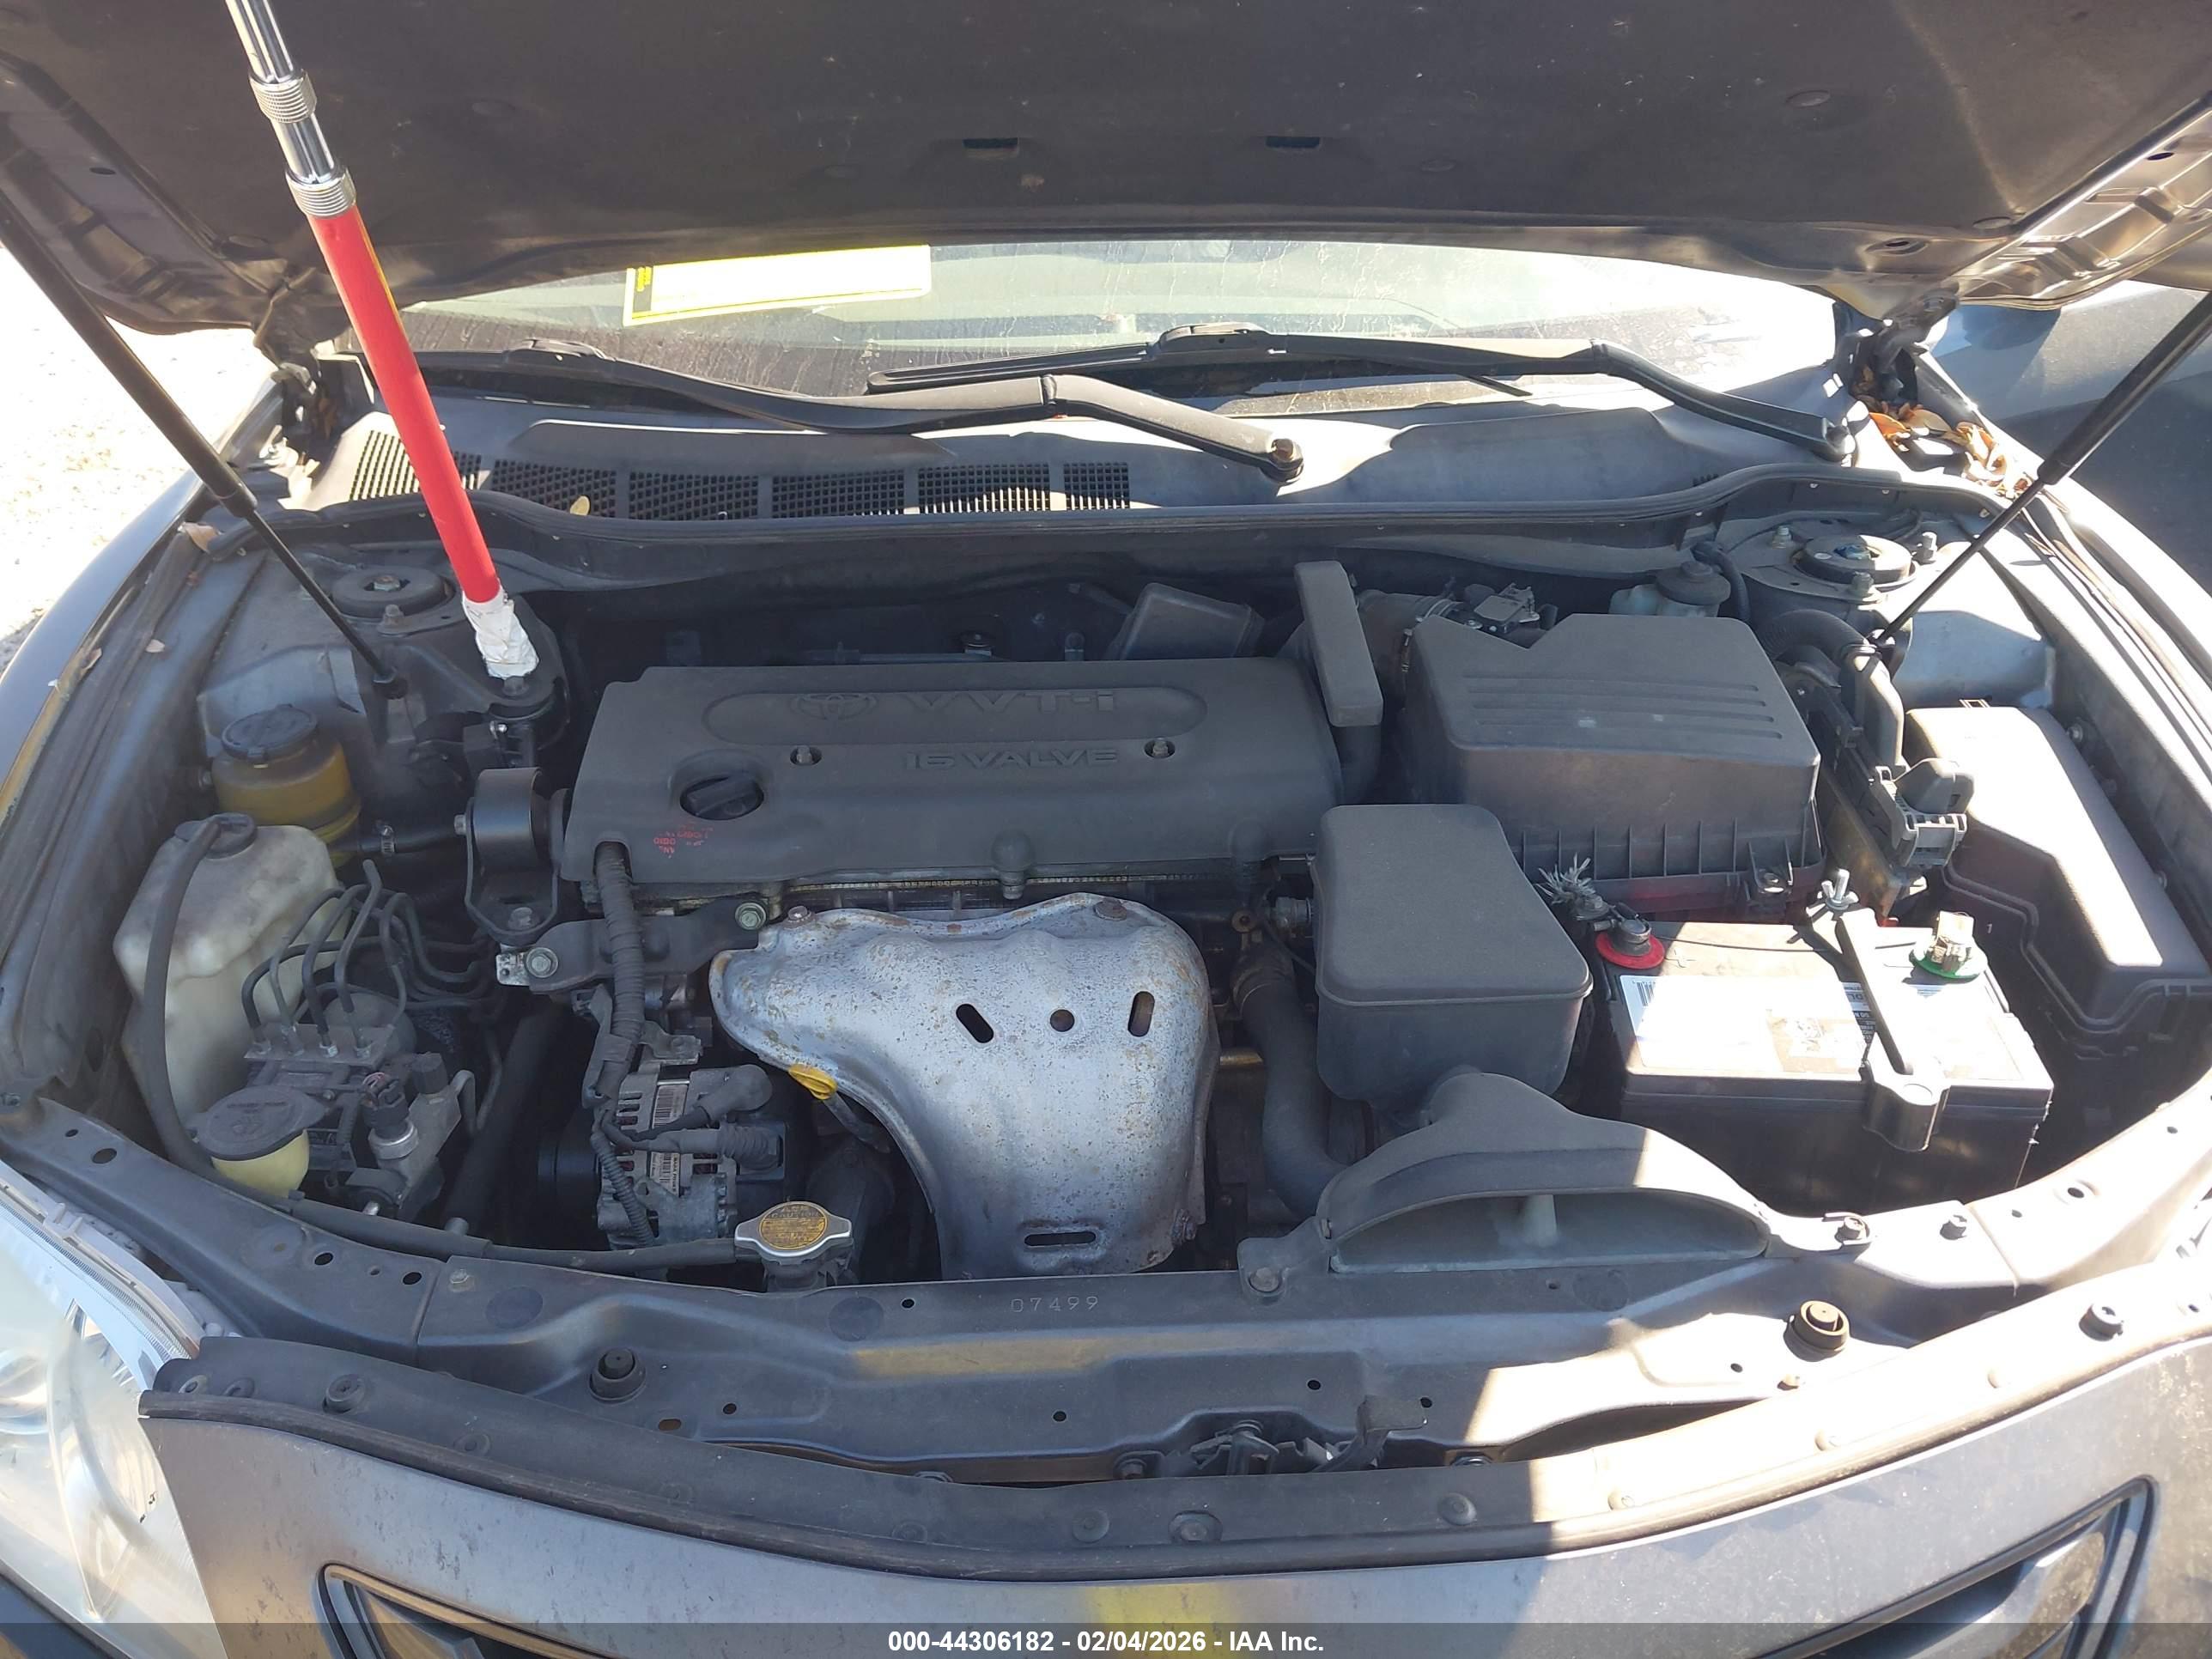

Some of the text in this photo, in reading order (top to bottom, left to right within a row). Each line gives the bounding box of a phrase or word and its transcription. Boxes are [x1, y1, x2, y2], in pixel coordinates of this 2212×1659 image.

[910, 748, 1118, 769] 16 VALVE
[1010, 1295, 1099, 1312] 07499
